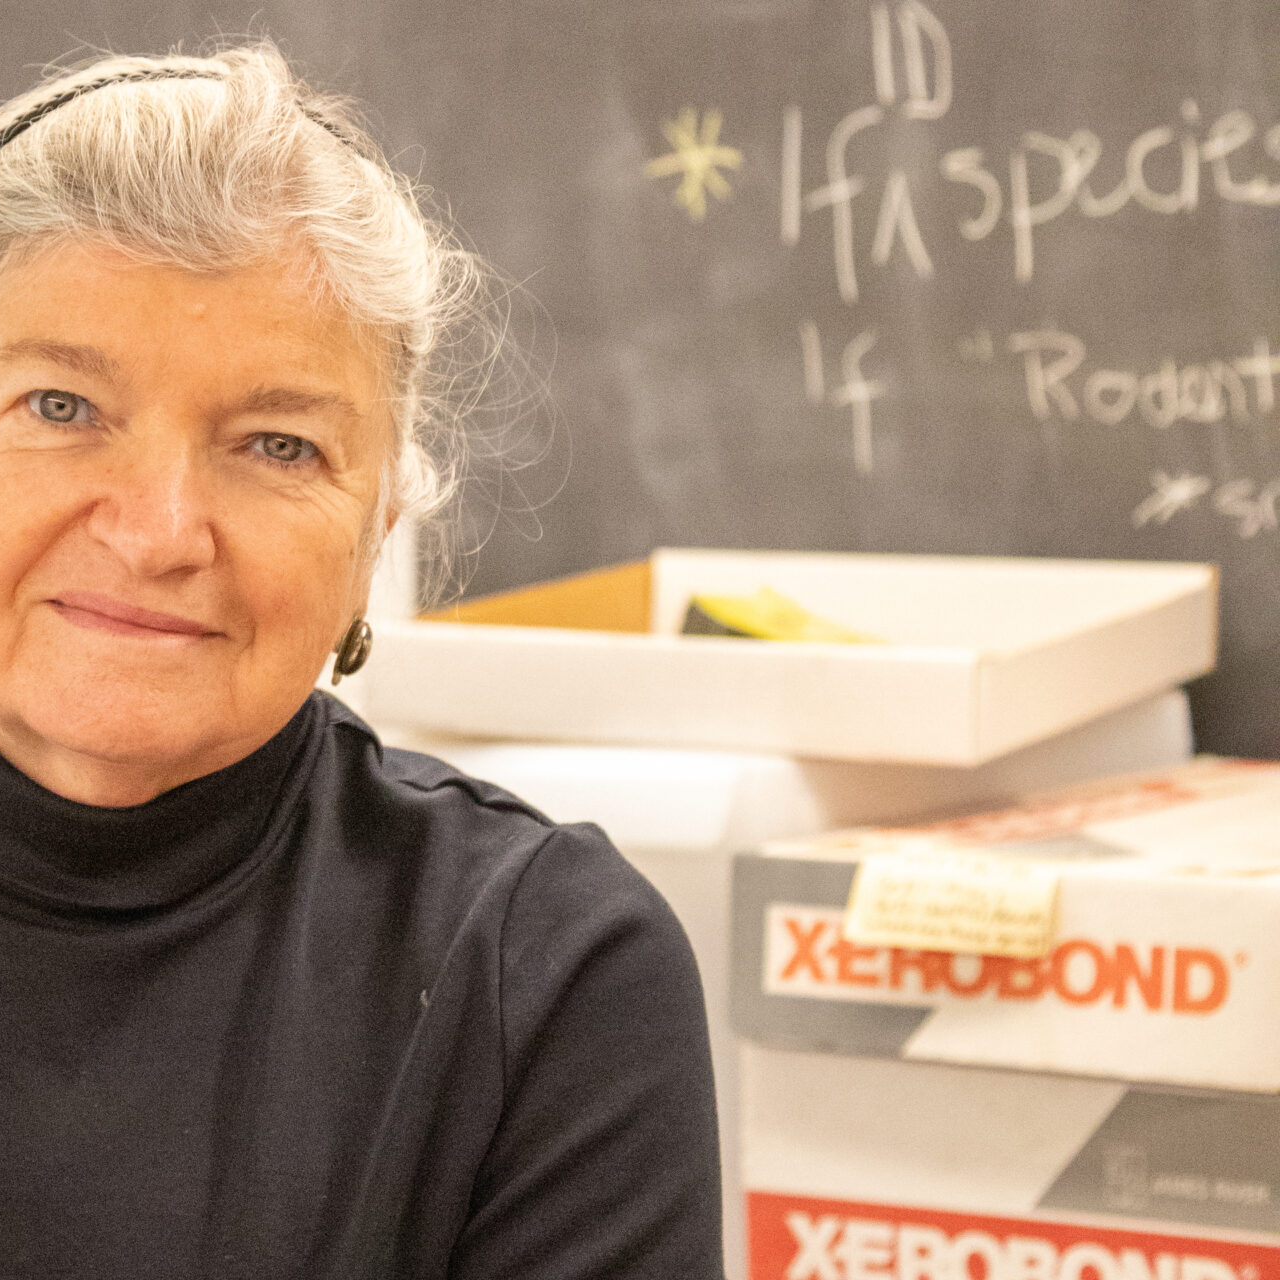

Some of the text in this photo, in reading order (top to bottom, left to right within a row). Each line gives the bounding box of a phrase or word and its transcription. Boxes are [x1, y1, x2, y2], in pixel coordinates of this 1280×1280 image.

[870, 2, 953, 119] ID
[781, 104, 883, 302] If
[800, 321, 885, 475] If
[780, 917, 1231, 1016] XEROBOND
